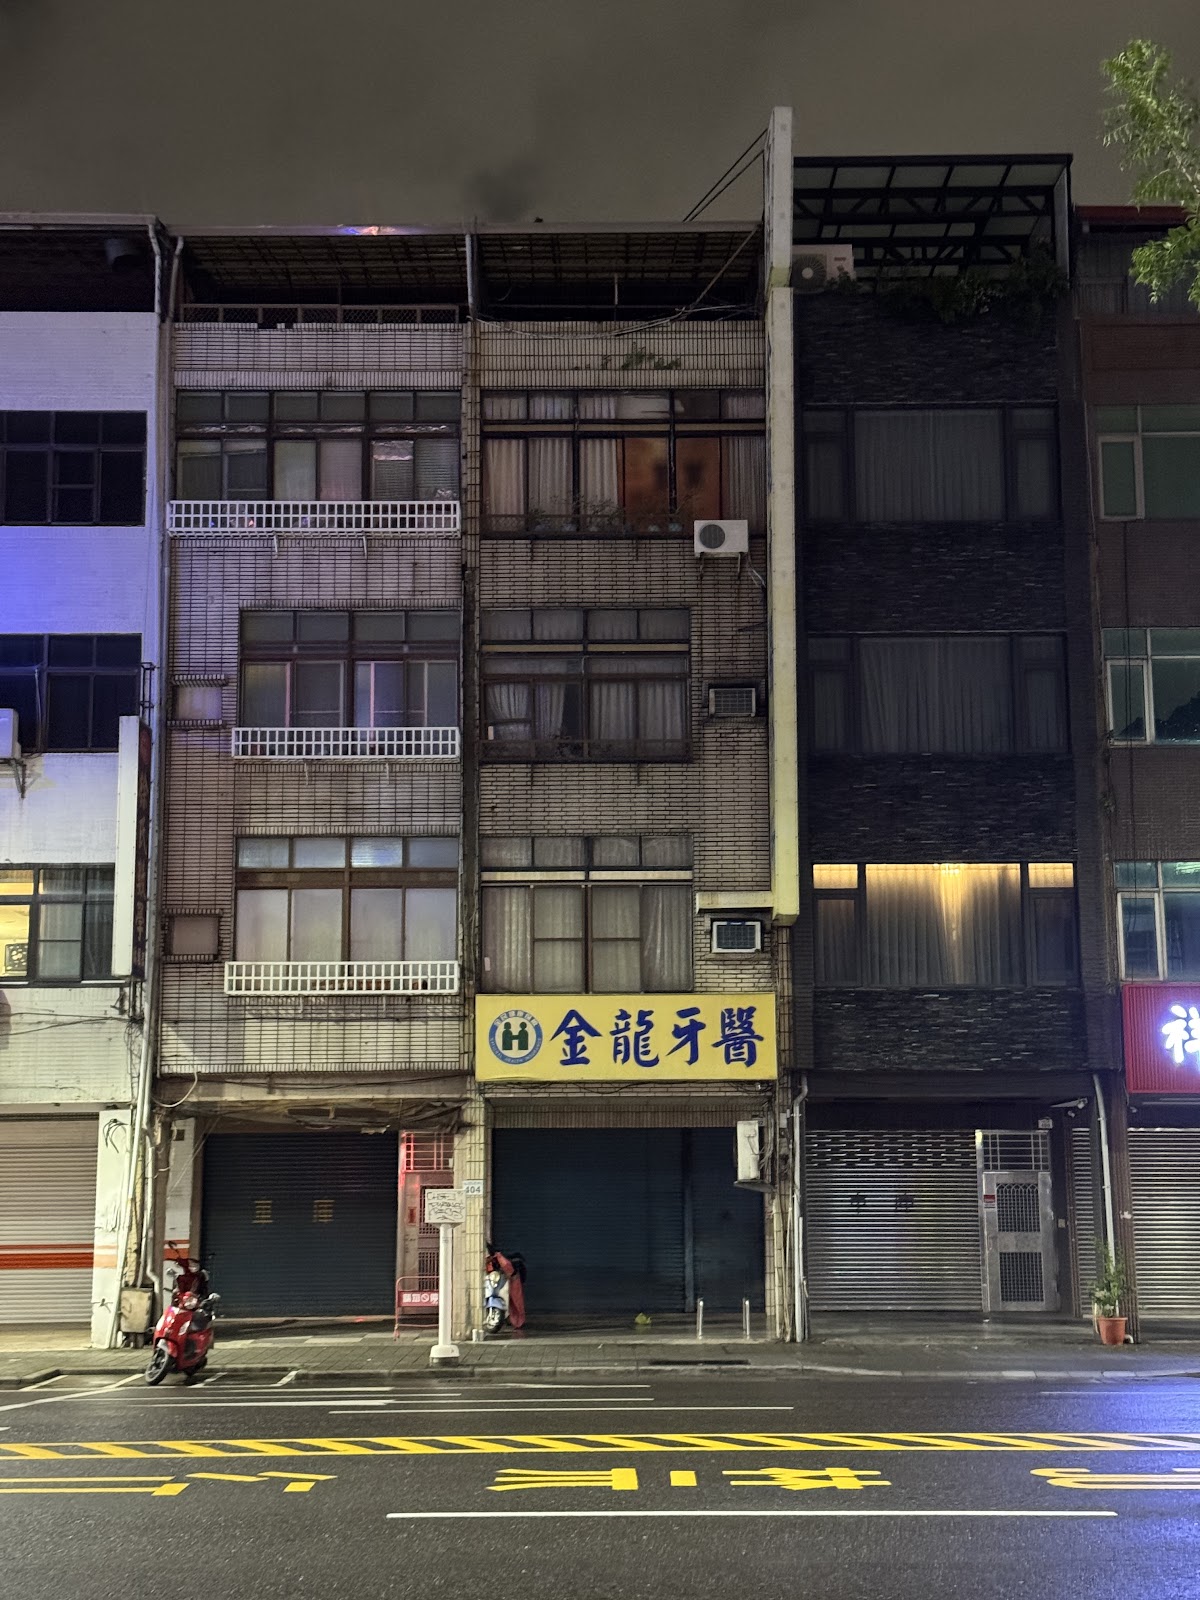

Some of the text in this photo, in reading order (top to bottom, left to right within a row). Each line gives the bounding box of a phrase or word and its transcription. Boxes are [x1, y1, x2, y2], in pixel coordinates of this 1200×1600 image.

[549, 1006, 764, 1068] 金龍牙醫
[464, 1185, 481, 1194] 404
